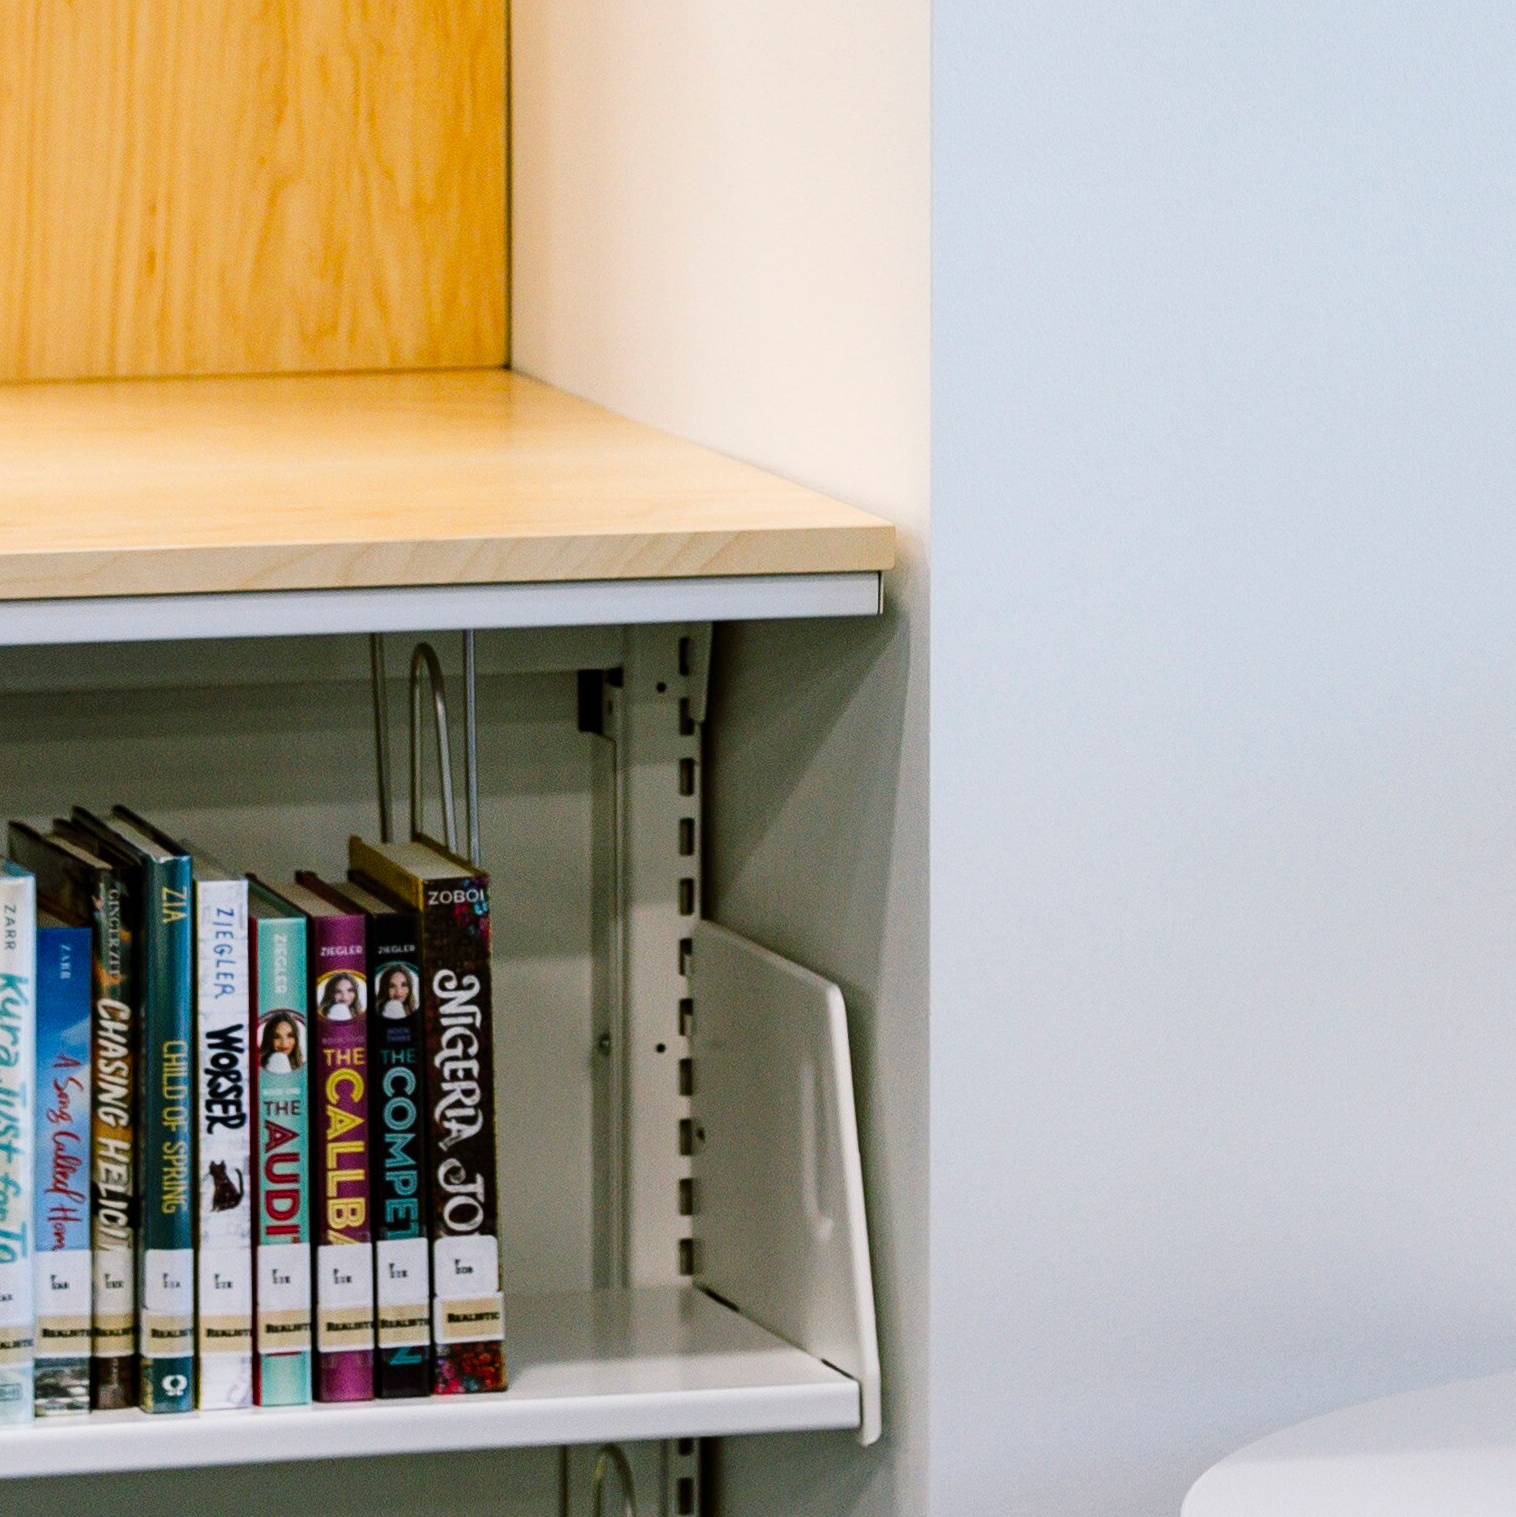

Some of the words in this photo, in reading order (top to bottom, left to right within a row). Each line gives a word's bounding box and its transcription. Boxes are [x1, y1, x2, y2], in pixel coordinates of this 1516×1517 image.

[106, 888, 121, 939] GINGER
[161, 886, 187, 925] ZIA
[428, 889, 485, 906] ZOBOI
[3, 904, 17, 951] ZARR
[320, 944, 363, 957] ZIEGLER
[378, 944, 416, 955] ZIEGLER
[108, 942, 121, 978] ZEE
[213, 907, 237, 1001] ZIEGLER
[96, 997, 132, 1129] CHASING
[161, 1039, 187, 1101] CHILD
[204, 1023, 247, 1135] WORSER
[323, 1047, 365, 1066] THE
[381, 1048, 417, 1064] THE
[433, 968, 484, 1152] NIGERIA
[45, 1076, 84, 1124] Song
[161, 1103, 186, 1133] OF
[263, 1099, 301, 1116] THE
[44, 1130, 86, 1206] Called
[161, 1140, 188, 1214] SPRING
[263, 1120, 302, 1243] AUDI
[437, 1157, 486, 1232] JO
[447, 1311, 500, 1323] REALISTIC
